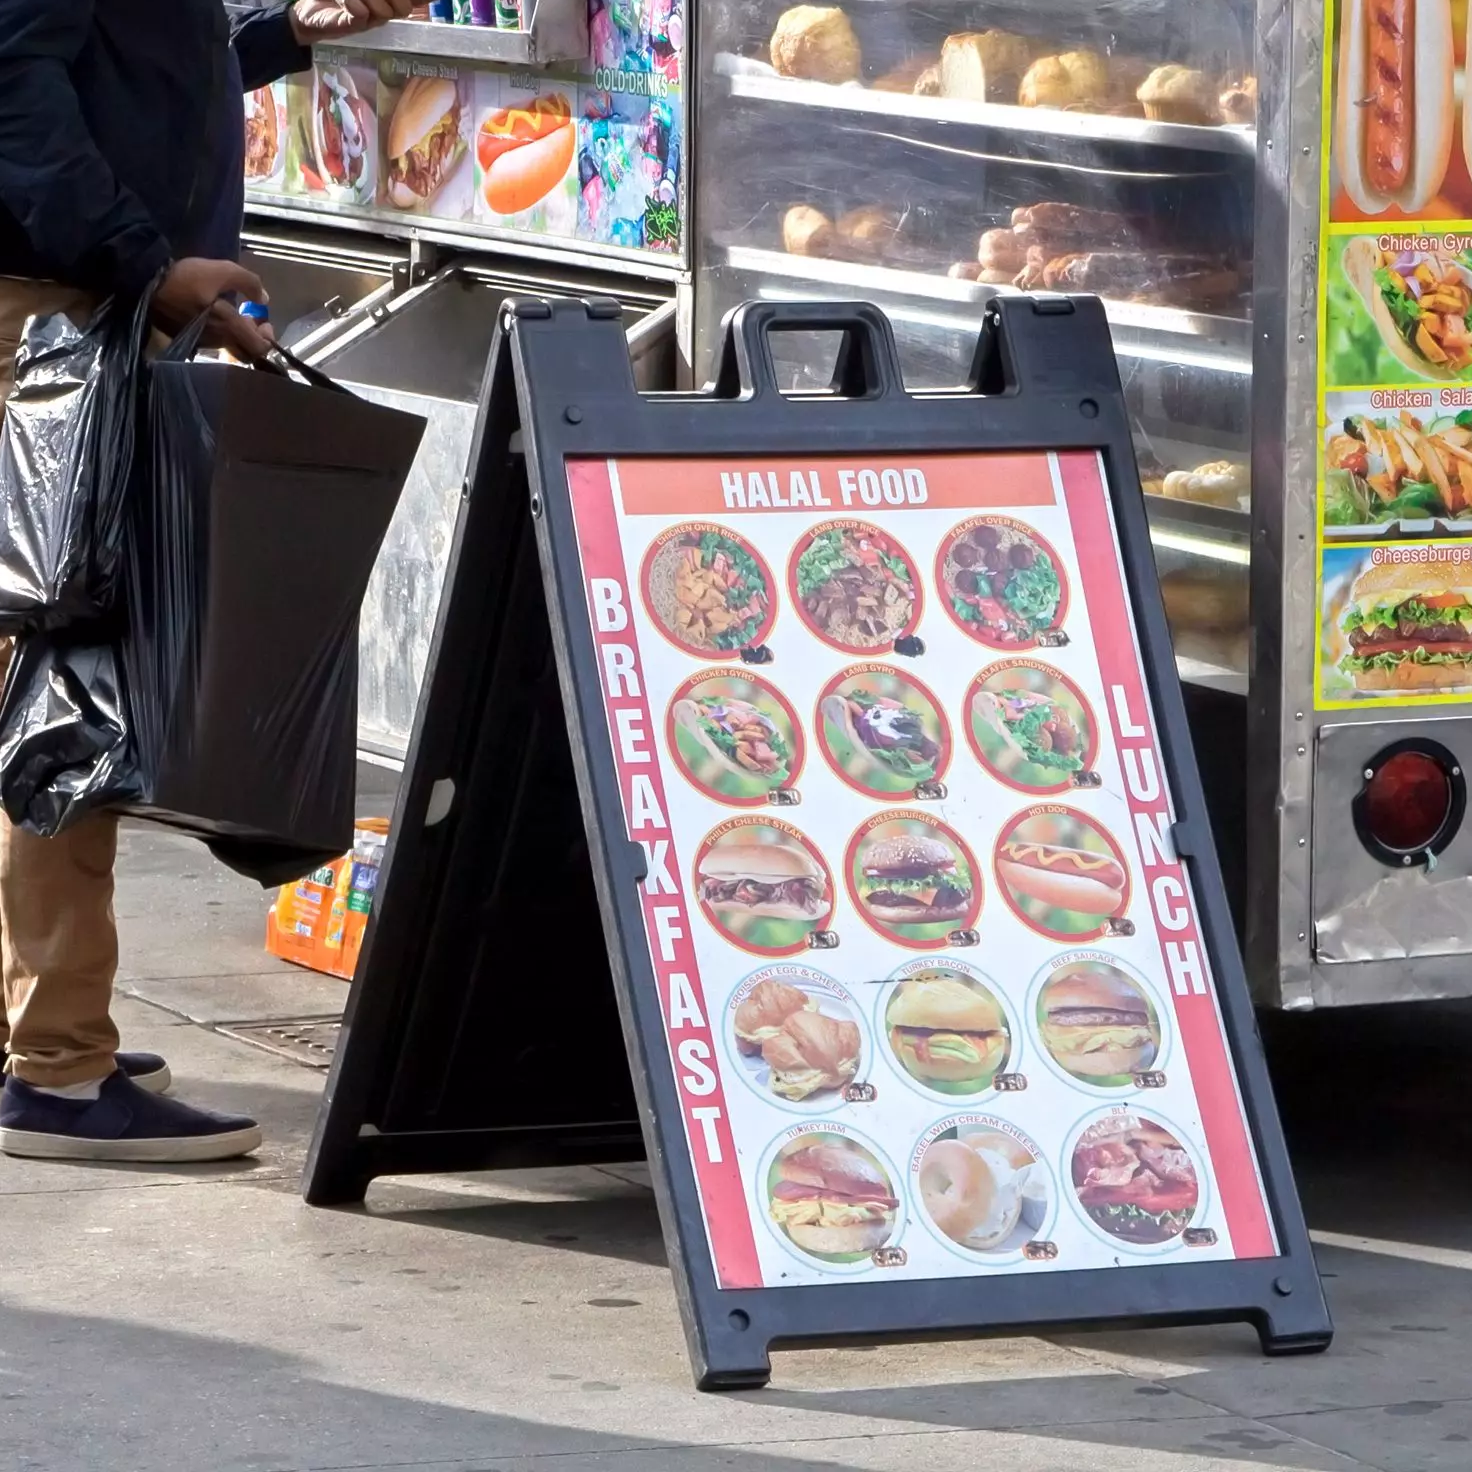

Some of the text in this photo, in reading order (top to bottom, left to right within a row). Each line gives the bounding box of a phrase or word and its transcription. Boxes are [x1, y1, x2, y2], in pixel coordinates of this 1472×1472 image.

[594, 67, 669, 99] COLD DRINKS
[1378, 233, 1439, 251] Chicken
[1370, 390, 1432, 409] Chicken
[720, 468, 929, 509] HALAL FOOD
[655, 523, 743, 547] CHICKEN OVER RICE
[808, 520, 882, 540] LAMB OVER RICE
[949, 516, 1036, 540] FALAFEL OVER RICE
[689, 669, 756, 687] CHICKEN GYRO
[843, 664, 896, 678] LAMB GYRO
[976, 657, 1064, 685] FALAFEL SANDWICH
[866, 809, 939, 829] CHEESEBURGER
[1028, 805, 1068, 817] HOT DOG
[704, 817, 803, 846] PHILLY CHEESE STEAK
[1111, 683, 1212, 998] LUNCH
[590, 576, 727, 1165] BREAKFAST
[900, 960, 971, 975] TURKEY BACON
[1050, 952, 1117, 969] BEEF SAUSAGE
[729, 967, 780, 1012] CROISSANT
[779, 966, 798, 977] EGG
[811, 971, 852, 1005] CHEESE
[1111, 1107, 1129, 1116] BLT
[786, 1124, 846, 1139] TURKEY HAM
[911, 1115, 1042, 1173] BAGEL WITH CREAM CHEESE
